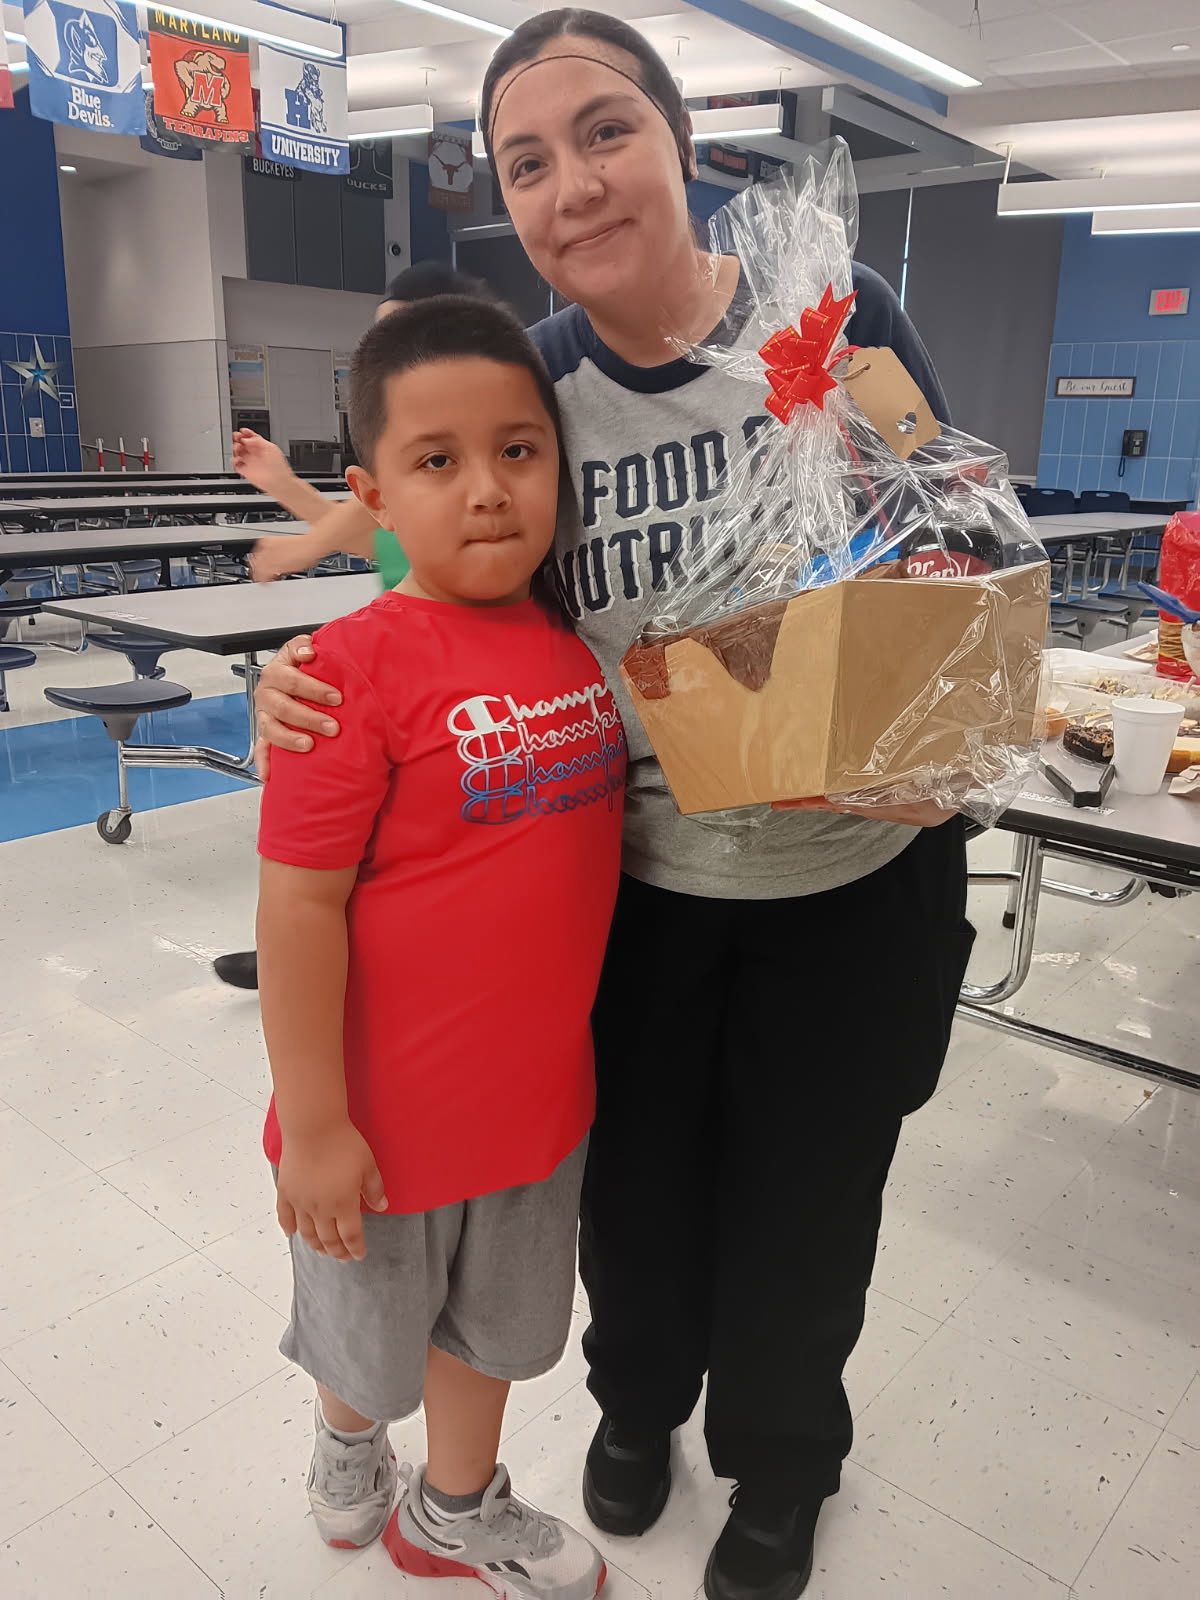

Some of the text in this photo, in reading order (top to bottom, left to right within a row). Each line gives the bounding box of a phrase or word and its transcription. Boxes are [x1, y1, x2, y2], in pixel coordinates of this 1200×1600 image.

[154, 9, 240, 44] MARYLAND
[71, 86, 101, 108] Blue
[191, 73, 223, 107] M
[68, 101, 115, 128] Devils.
[162, 116, 249, 143] TERRAPINS
[271, 134, 340, 167] UNIVERSITY
[253, 158, 295, 178] BUCKEYES
[581, 430, 732, 528] FOOD
[554, 510, 742, 620] NUTRI
